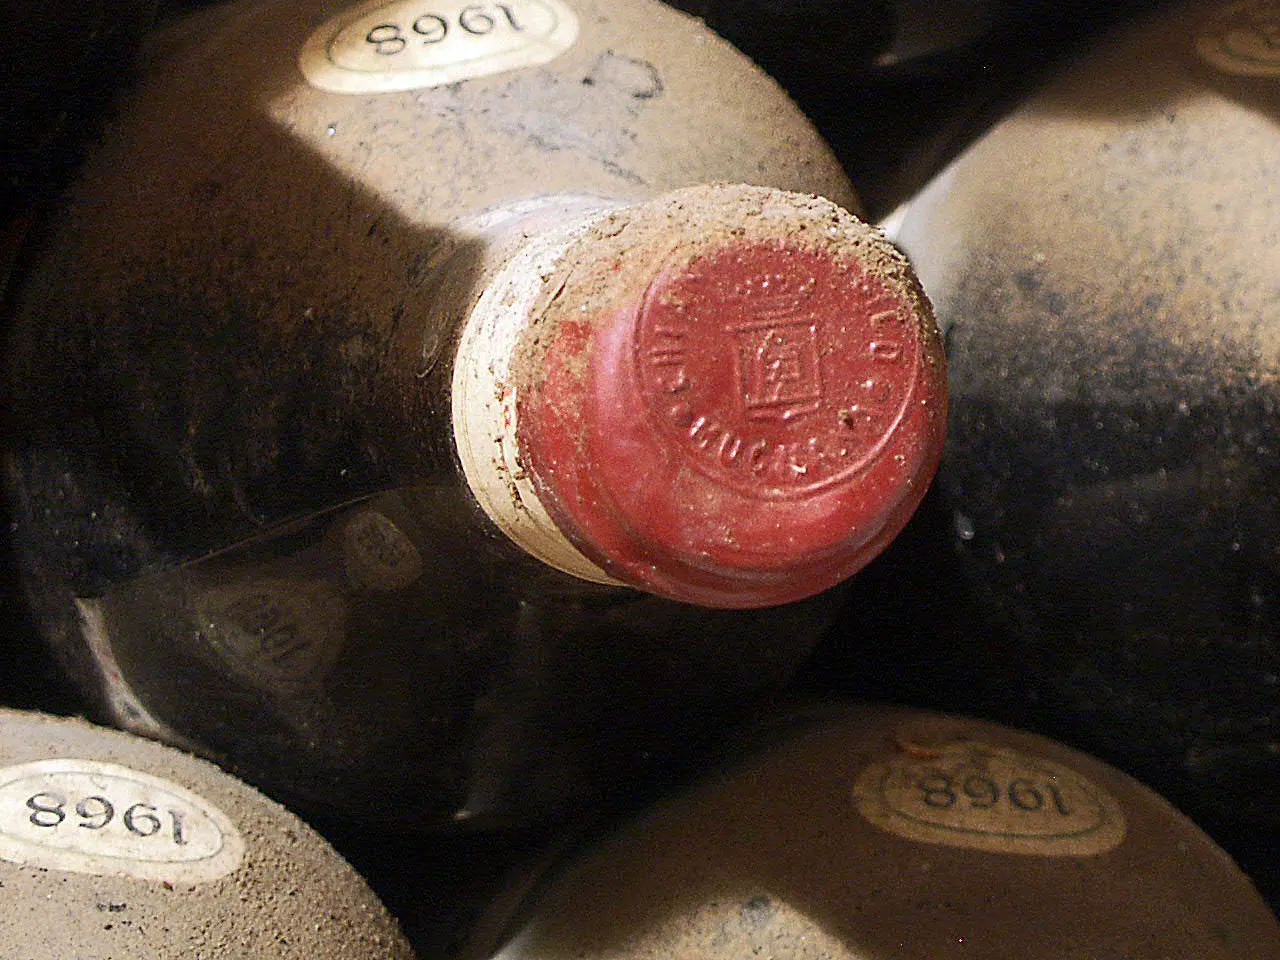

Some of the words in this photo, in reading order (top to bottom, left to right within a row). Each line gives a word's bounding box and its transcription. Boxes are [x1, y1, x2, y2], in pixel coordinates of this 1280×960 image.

[364, 2, 528, 57] 1968
[26, 792, 188, 847] 1968
[917, 773, 1072, 817] 1968
